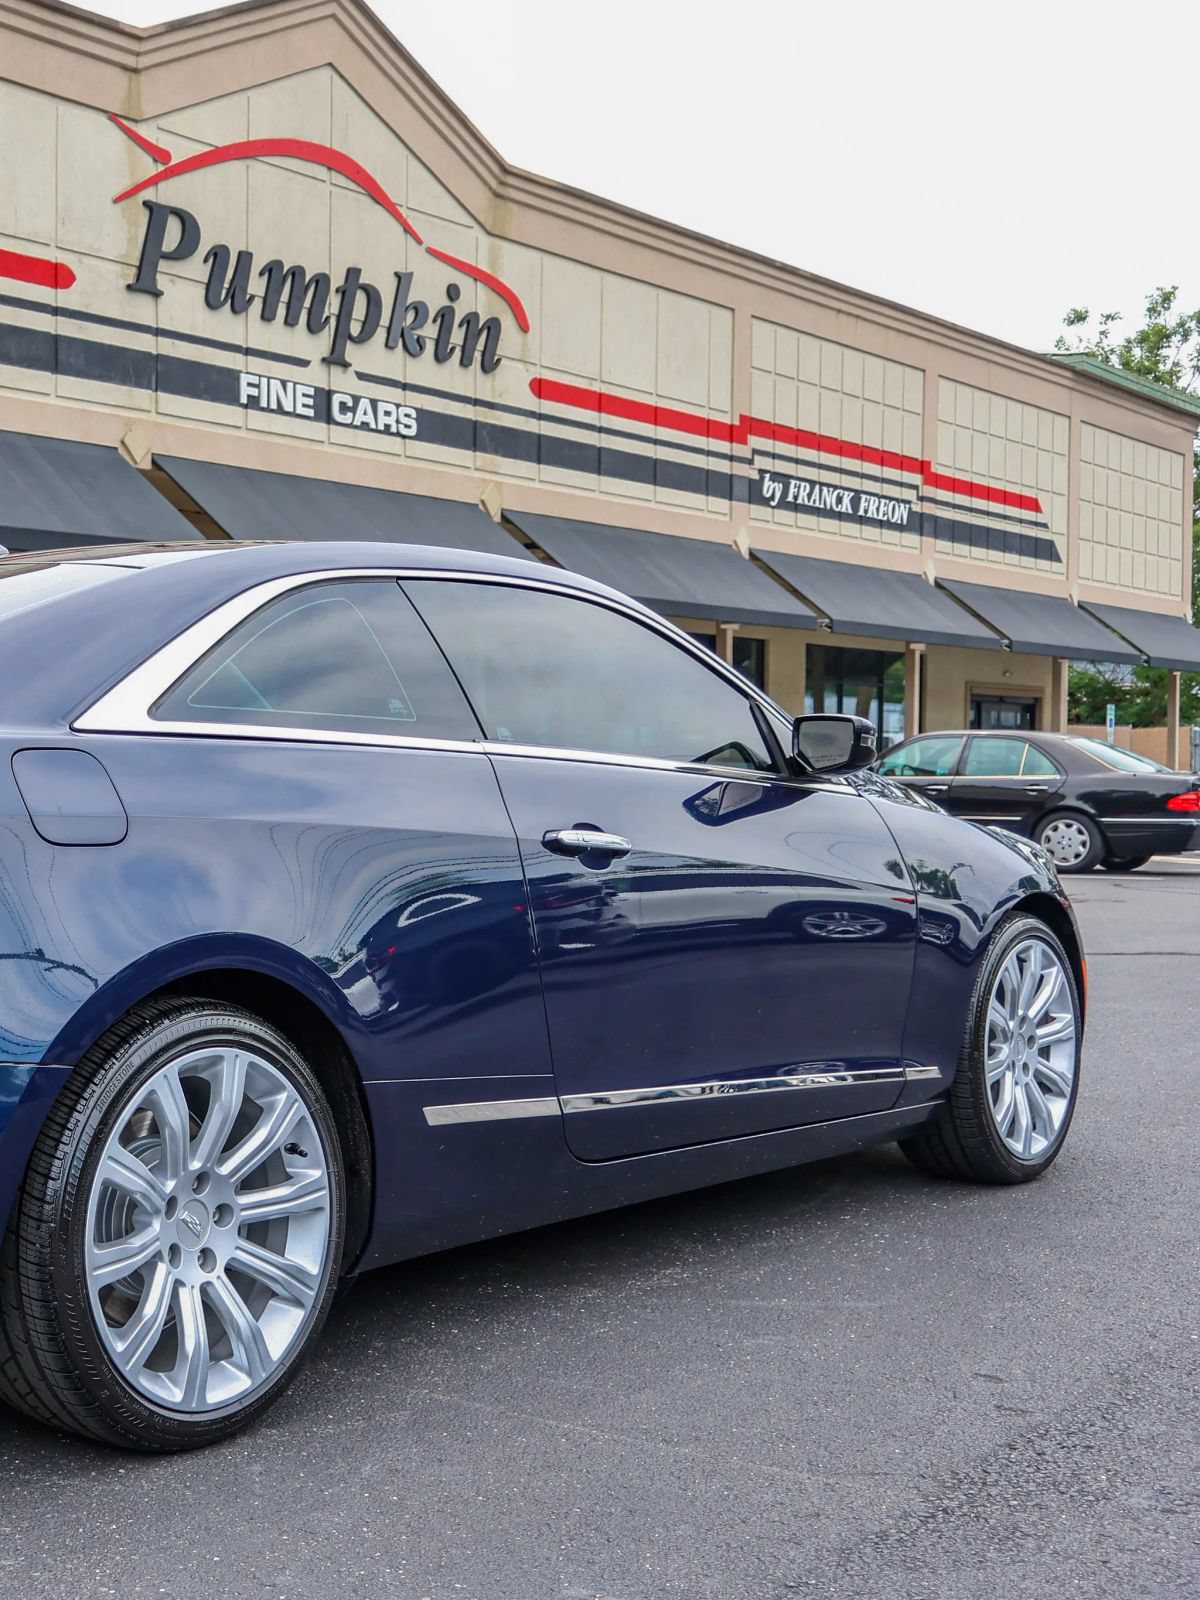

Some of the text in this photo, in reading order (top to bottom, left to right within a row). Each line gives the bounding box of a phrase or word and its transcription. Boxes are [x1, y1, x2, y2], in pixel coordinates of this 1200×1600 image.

[126, 200, 502, 374] Pumpkin
[239, 373, 418, 437] FINE CARS
[762, 474, 910, 525] by FRANCK FREON
[95, 1060, 135, 1113] BRIDGESTONE
